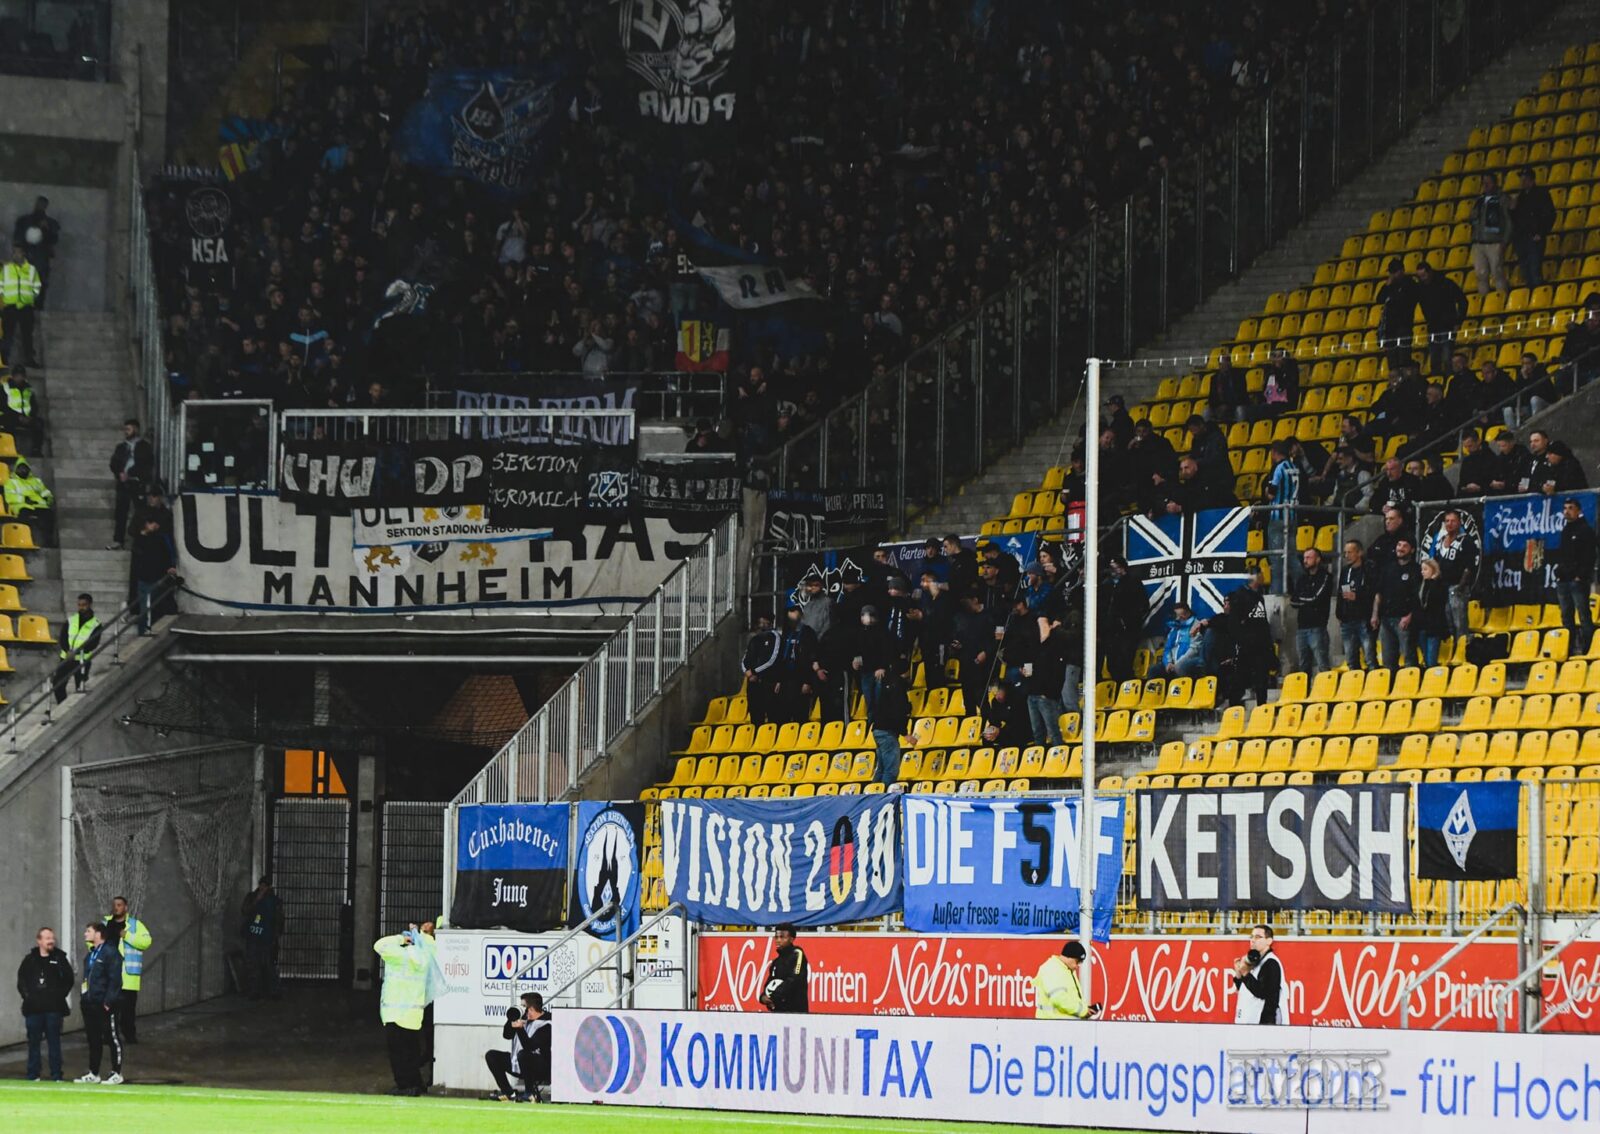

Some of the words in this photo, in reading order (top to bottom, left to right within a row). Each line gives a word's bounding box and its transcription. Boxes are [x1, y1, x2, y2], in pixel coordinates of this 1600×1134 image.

[387, 526, 432, 538] SEKTION
[263, 566, 573, 606] MANNHEIM
[1213, 560, 1224, 573] 68
[468, 817, 559, 858] Cuxhavener
[661, 801, 795, 912] VISION
[906, 799, 975, 886] DIE
[1139, 788, 1406, 902] KETSCH
[491, 877, 528, 907] Jung
[933, 902, 965, 930] Außer
[967, 901, 999, 926] fresse
[807, 960, 867, 1003] rinten
[874, 937, 972, 1016] Nobis
[1110, 939, 1219, 1021] Nobis
[1312, 941, 1430, 1027] Nobis
[969, 1043, 1023, 1095] Die
[1034, 1045, 1377, 1118] Bildungsplattform
[1418, 1059, 1476, 1117] für
